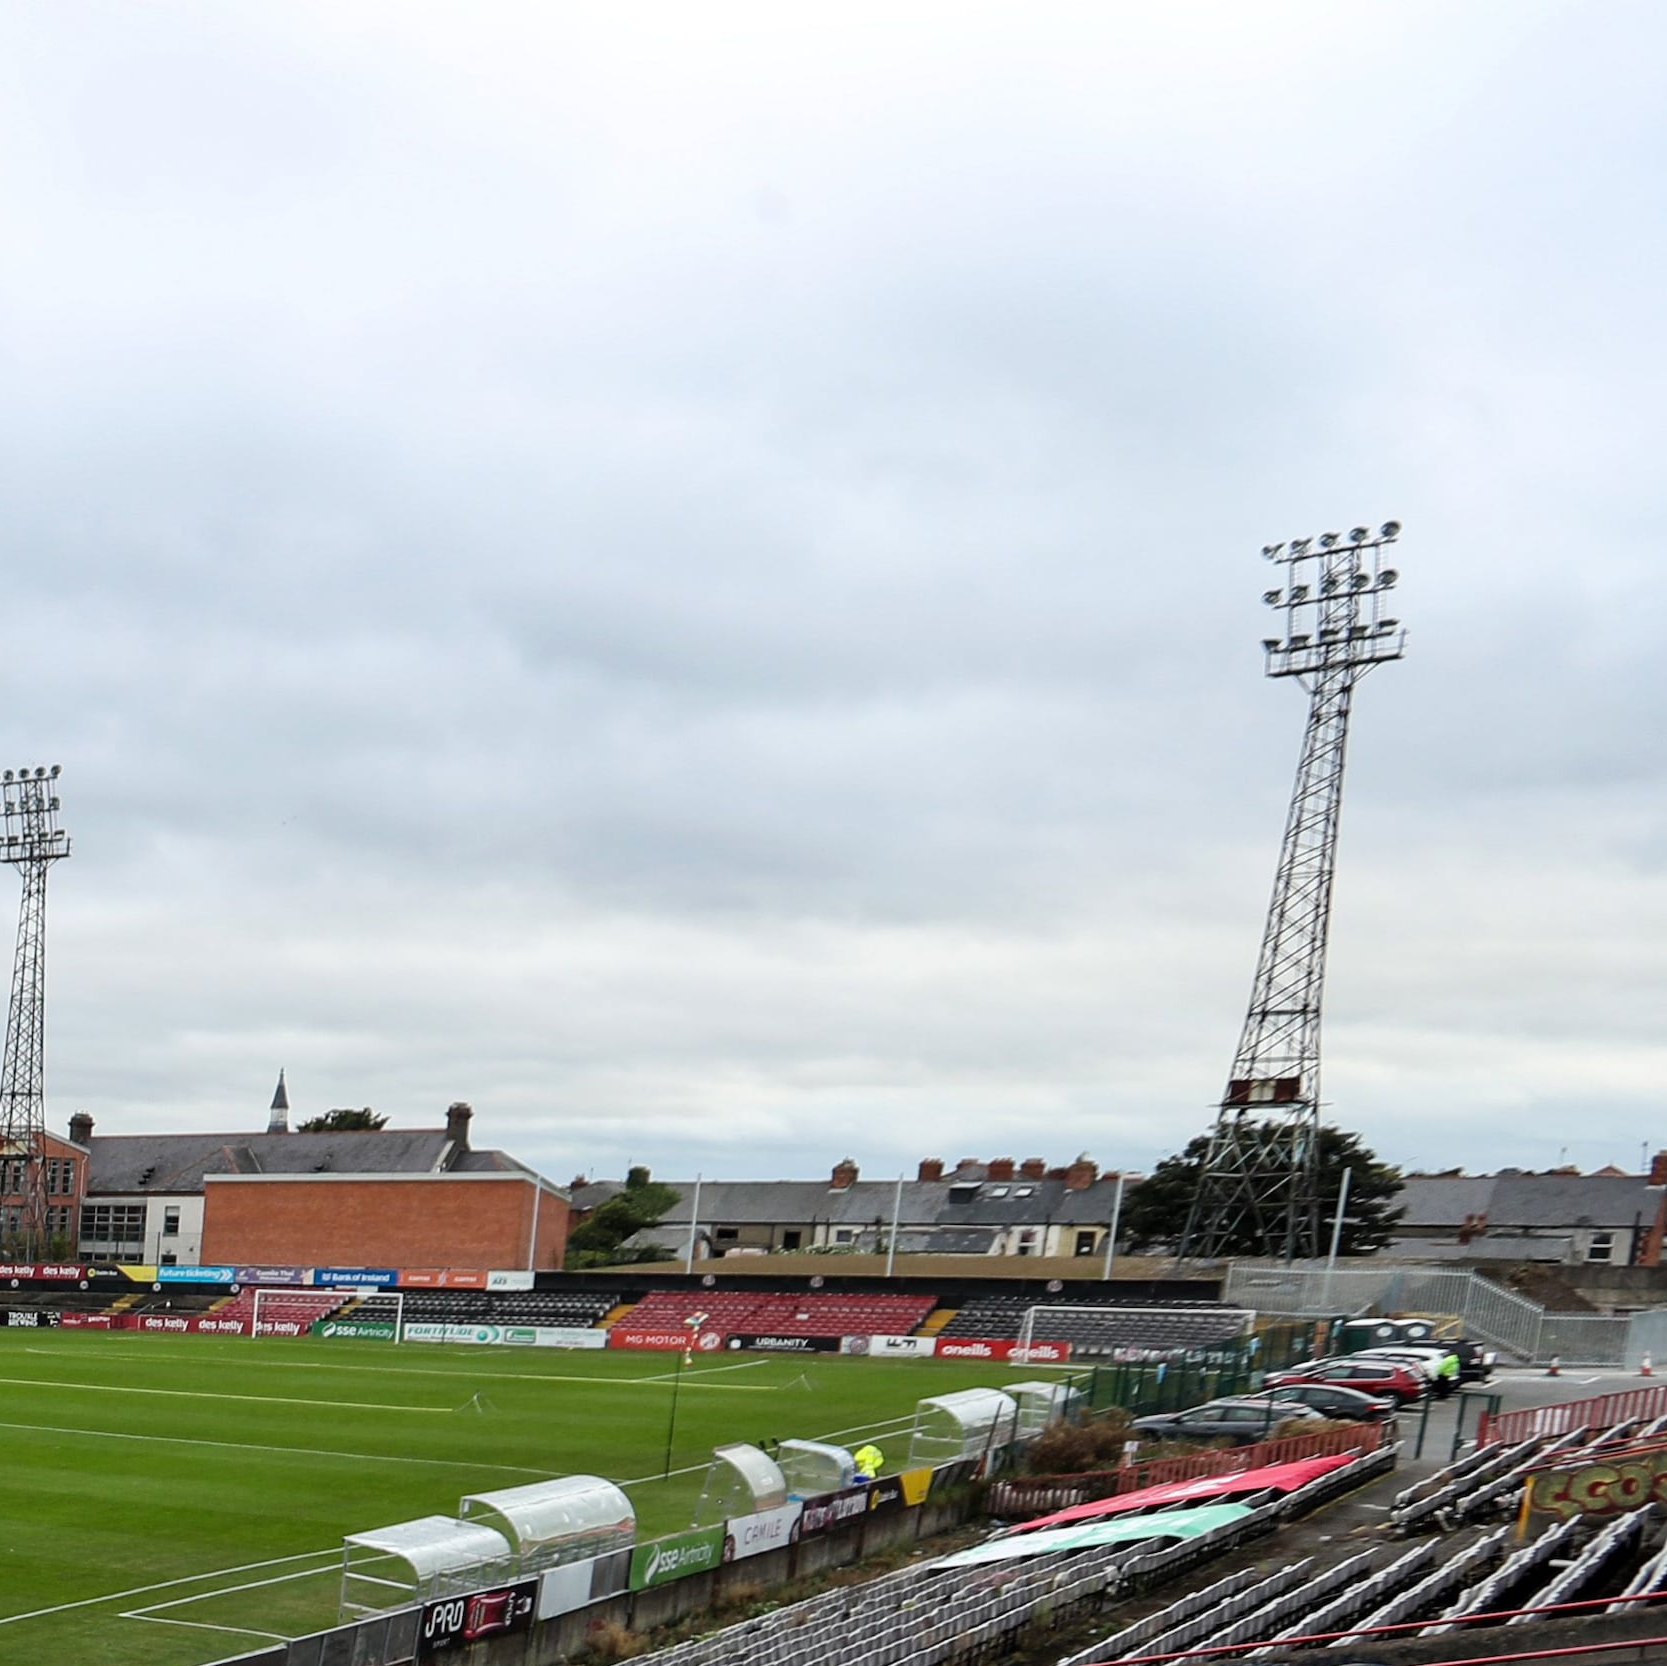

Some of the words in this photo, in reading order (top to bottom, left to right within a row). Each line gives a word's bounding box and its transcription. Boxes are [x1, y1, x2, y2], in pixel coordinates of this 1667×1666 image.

[14, 1265, 35, 1278] kelly
[43, 1266, 58, 1275] des
[59, 1266, 81, 1279] kelly
[159, 1269, 184, 1278] future
[185, 1269, 221, 1279] ticketing
[332, 1273, 352, 1281] Bank
[353, 1273, 360, 1281] of
[360, 1274, 390, 1282] Ireland
[8, 1311, 38, 1320] TROUBLE
[145, 1318, 164, 1328] des
[164, 1317, 189, 1331] kelly
[199, 1319, 217, 1330] des
[218, 1319, 244, 1333] kelly
[255, 1320, 273, 1331] des
[274, 1320, 301, 1336] kelly
[336, 1324, 357, 1336] sse
[357, 1326, 395, 1339] Airtricity
[625, 1335, 643, 1344] MG
[643, 1335, 687, 1346] MOTOR
[756, 1337, 810, 1347] URBANITY
[744, 1517, 781, 1546] CAMILE
[657, 1551, 679, 1574] sse
[679, 1543, 714, 1570] Airtricity
